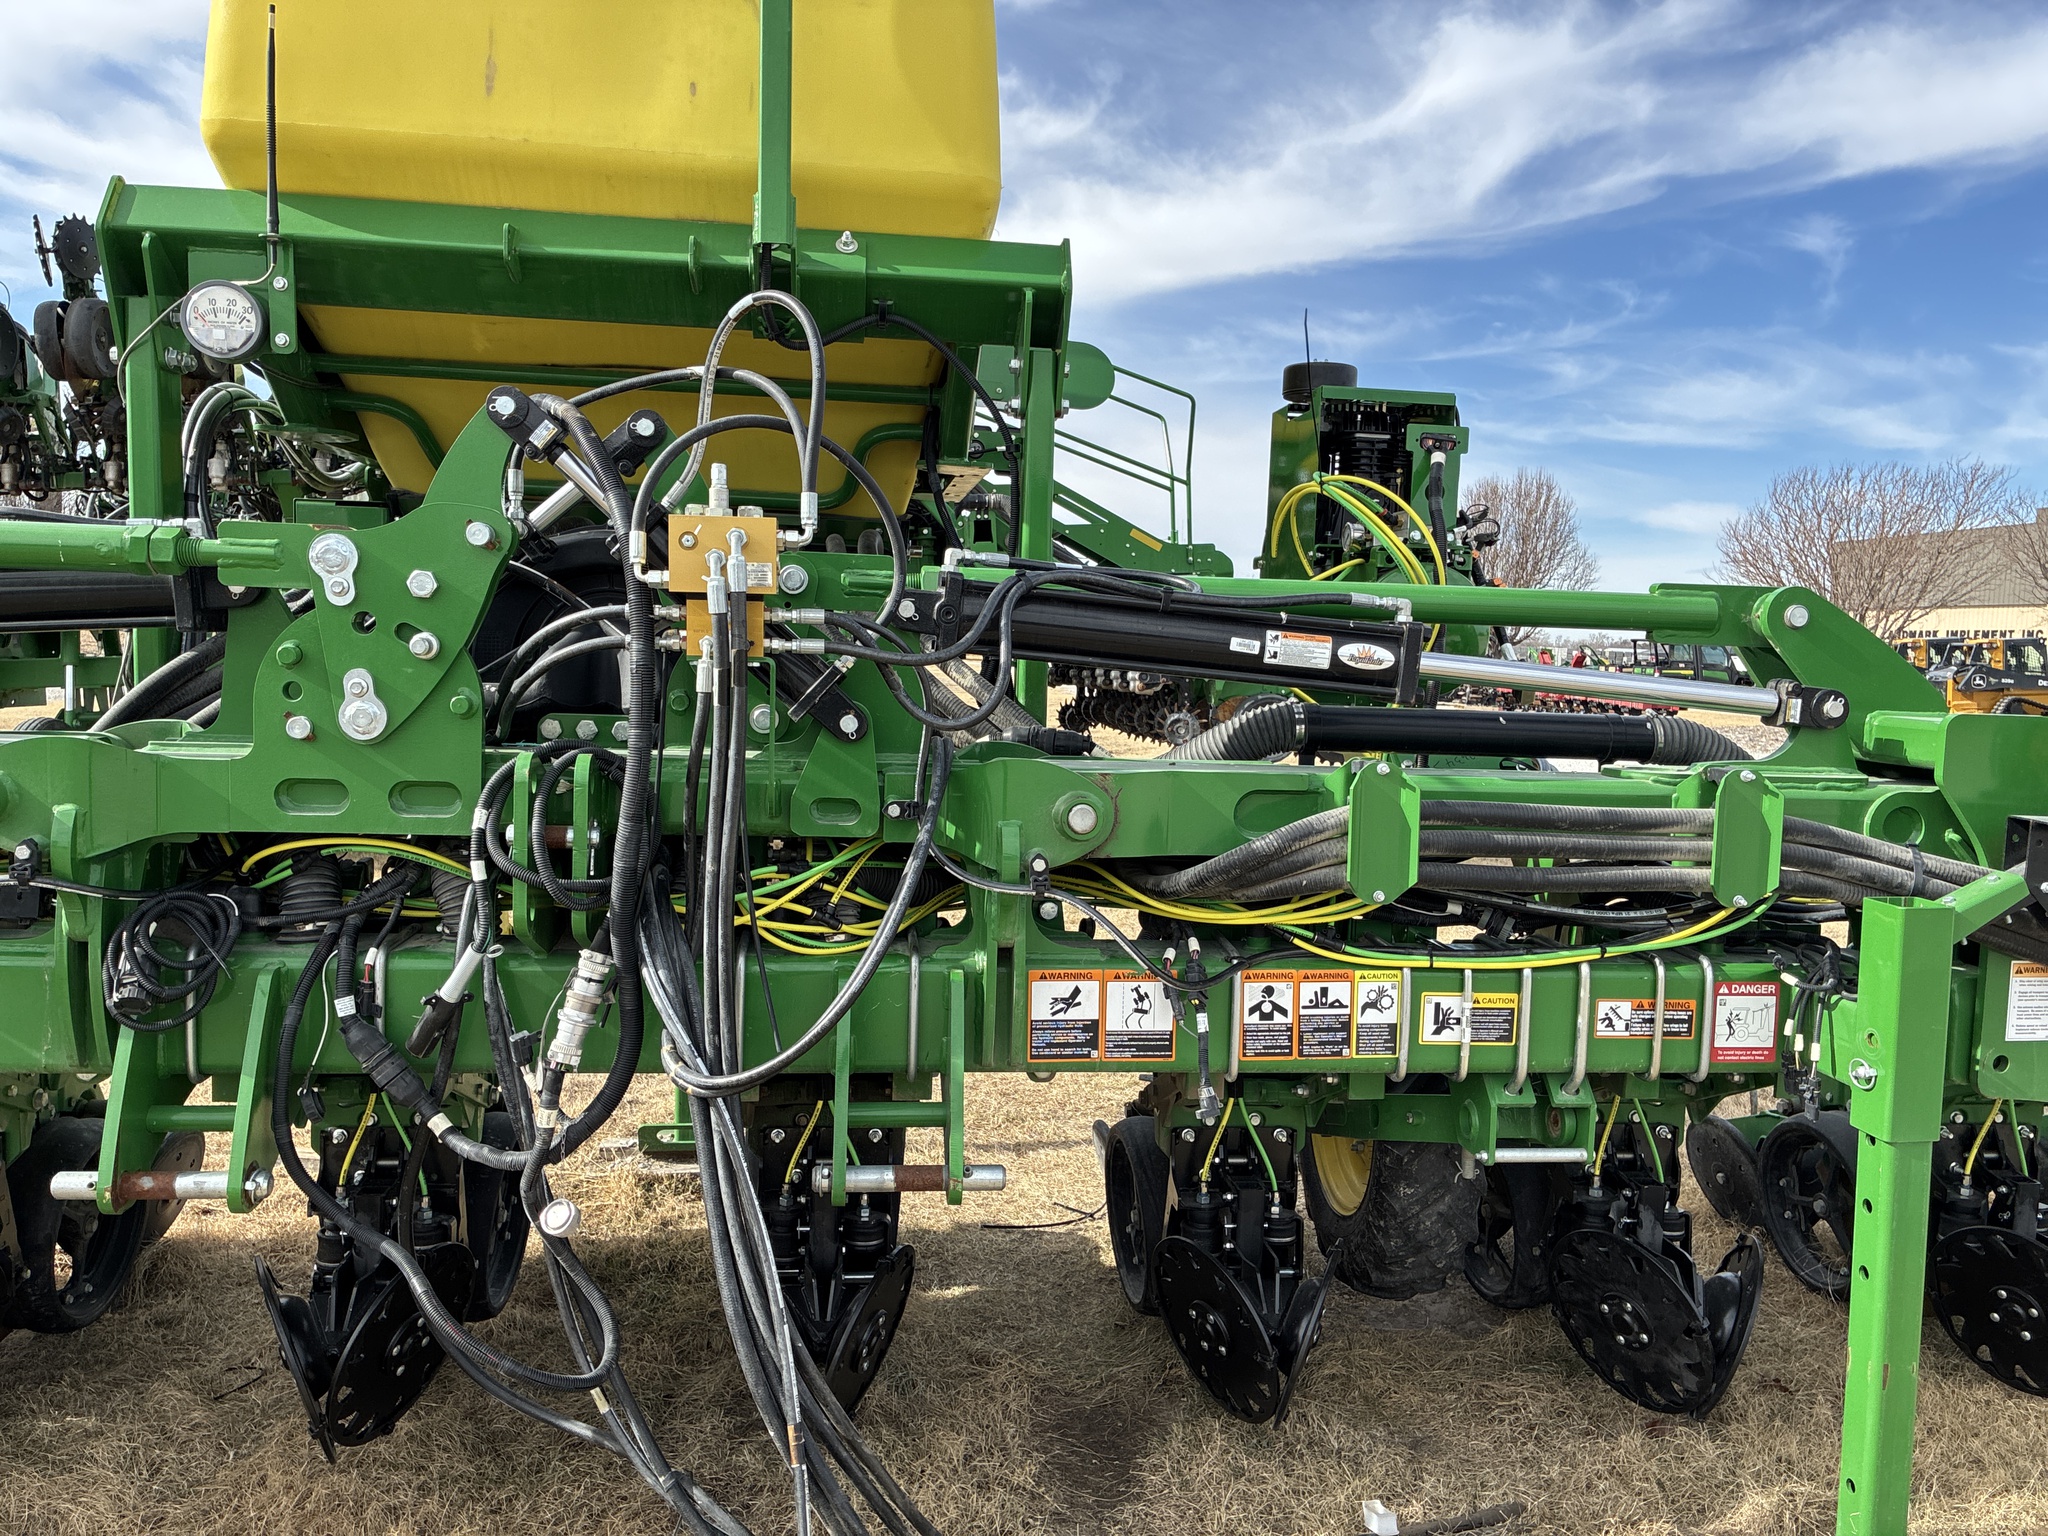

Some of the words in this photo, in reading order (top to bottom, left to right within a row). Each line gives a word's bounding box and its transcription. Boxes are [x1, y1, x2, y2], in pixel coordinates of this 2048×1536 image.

[208, 298, 216, 306] 10
[226, 298, 237, 307] 20
[194, 306, 199, 314] 0
[242, 306, 253, 314] 30
[1946, 630, 2015, 639] IMPLEMENT
[1252, 972, 1294, 980] WARNING
[1310, 972, 1349, 980] WARNING
[1732, 985, 1775, 994] DANGER
[1648, 1001, 1690, 1009] WRNING
